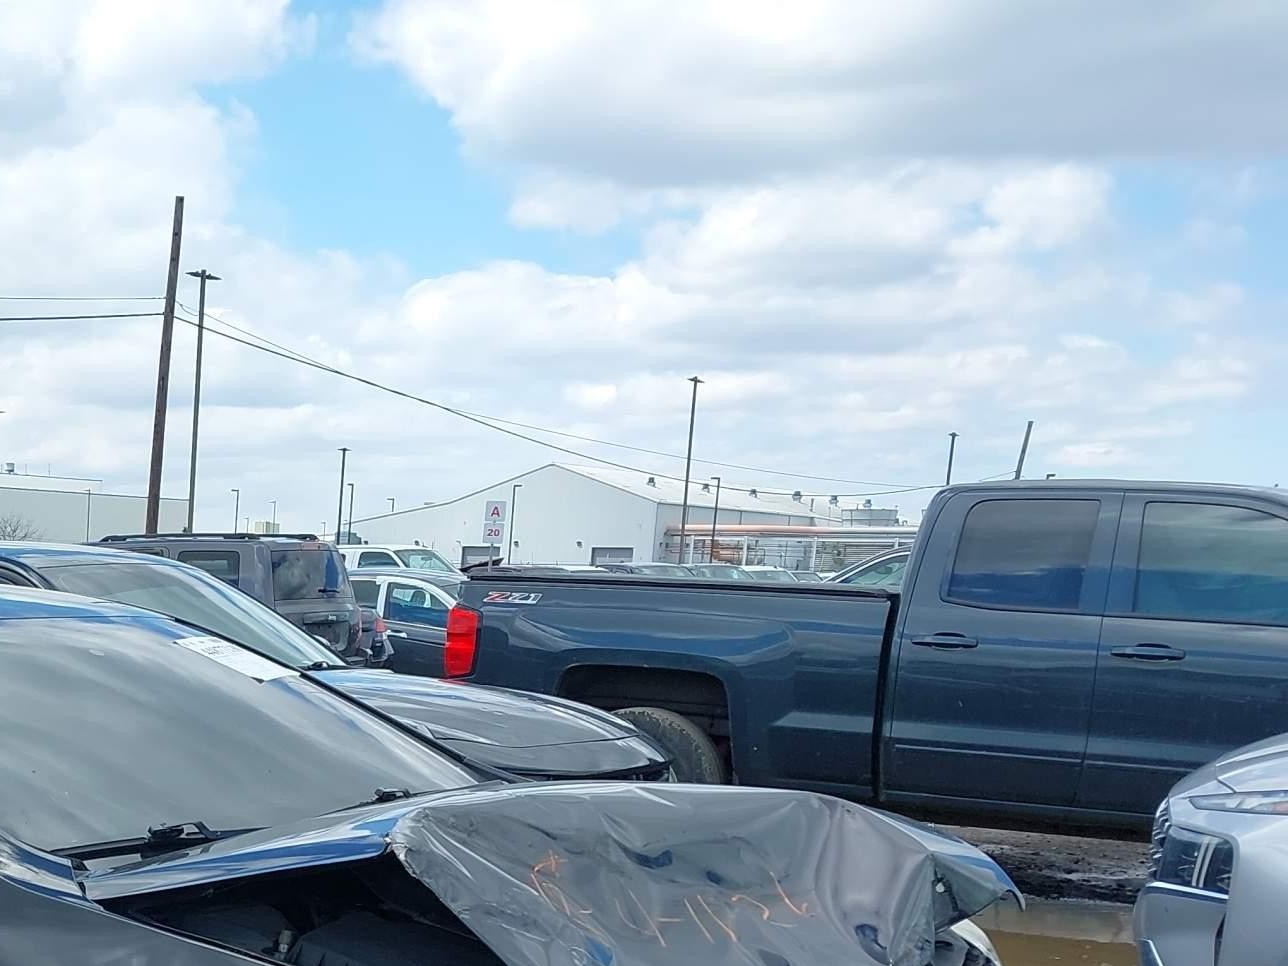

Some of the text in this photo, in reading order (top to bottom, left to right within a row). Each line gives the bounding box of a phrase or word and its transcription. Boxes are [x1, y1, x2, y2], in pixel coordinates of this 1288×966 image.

[490, 506, 501, 518] A
[486, 528, 501, 538] 20
[483, 591, 543, 605] Z71
